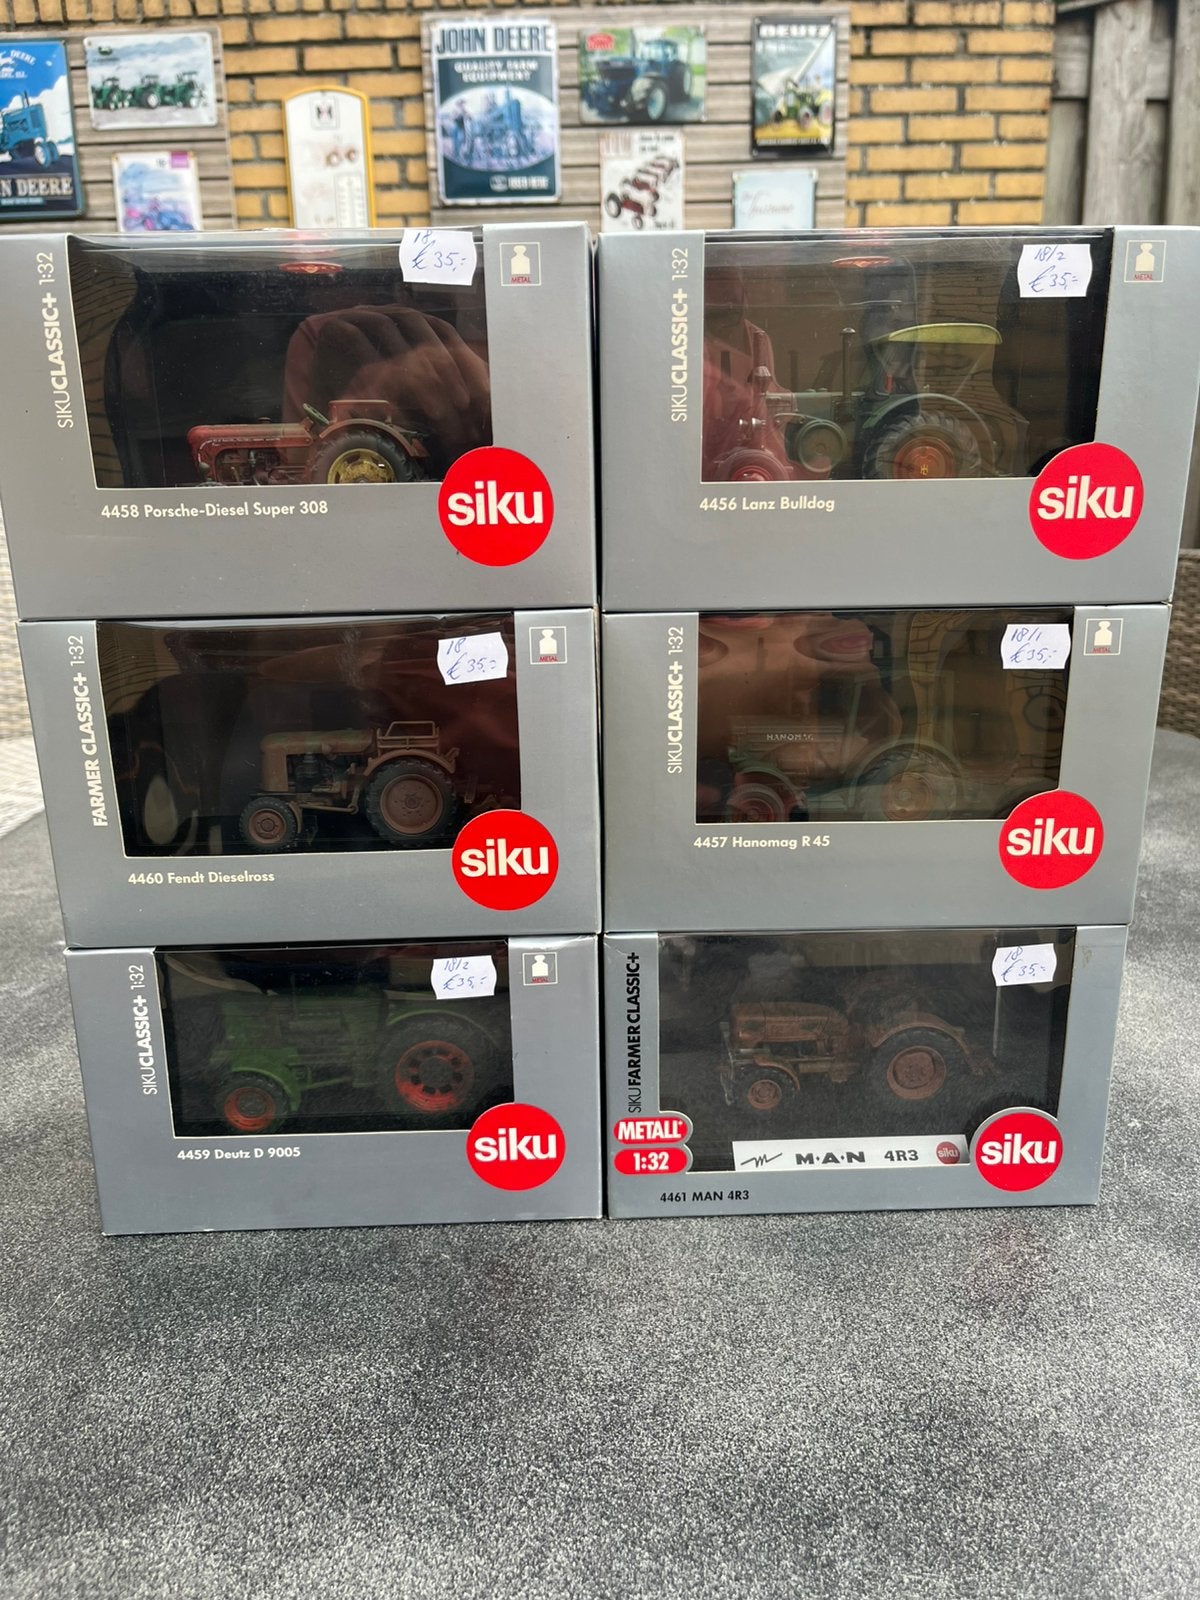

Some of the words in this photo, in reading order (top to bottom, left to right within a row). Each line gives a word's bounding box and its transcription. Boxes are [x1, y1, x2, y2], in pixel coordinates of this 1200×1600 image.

[436, 28, 486, 53] JOHN
[493, 25, 554, 51] DEERE
[16, 176, 74, 196] DEERE
[414, 230, 433, 243] 18
[671, 248, 688, 281] 1:32
[1034, 245, 1066, 262] 18/2
[36, 252, 55, 286] 1:32
[101, 504, 139, 518] 4458
[145, 502, 249, 518] Porsche-Diesel
[253, 501, 295, 518] Super
[300, 500, 328, 514] 308
[447, 480, 544, 526] siku
[699, 497, 737, 511] 4456
[742, 497, 776, 511] Lanz
[780, 495, 835, 512] Bulldog
[1037, 475, 1135, 520] siku
[67, 635, 86, 667] 1:32
[446, 637, 467, 655] 18
[667, 626, 684, 656] 1:32
[73, 672, 97, 756] CLASSIC+
[85, 759, 108, 826] FARMER
[693, 836, 728, 849] 4457
[732, 836, 797, 850] Hanomag
[801, 835, 811, 847] R
[812, 835, 830, 847] 45
[1006, 818, 1095, 857] siku
[460, 838, 549, 878] siku
[128, 872, 164, 885] 4460
[167, 871, 205, 884] Fendt
[208, 870, 276, 883] Dieselross
[128, 964, 146, 990] 1:32
[177, 1149, 211, 1160] 4459
[214, 1148, 251, 1159] Deutz
[254, 1147, 264, 1159] D
[267, 1147, 301, 1158] 9005
[473, 1127, 558, 1162] siku
[884, 1149, 919, 1162] 4R3
[937, 1148, 959, 1159] siku
[980, 1133, 1057, 1165] siku
[632, 1151, 670, 1171] 1:32
[660, 1192, 688, 1203] 4461
[692, 1191, 723, 1202] MAN
[727, 1190, 750, 1201] 4R3
